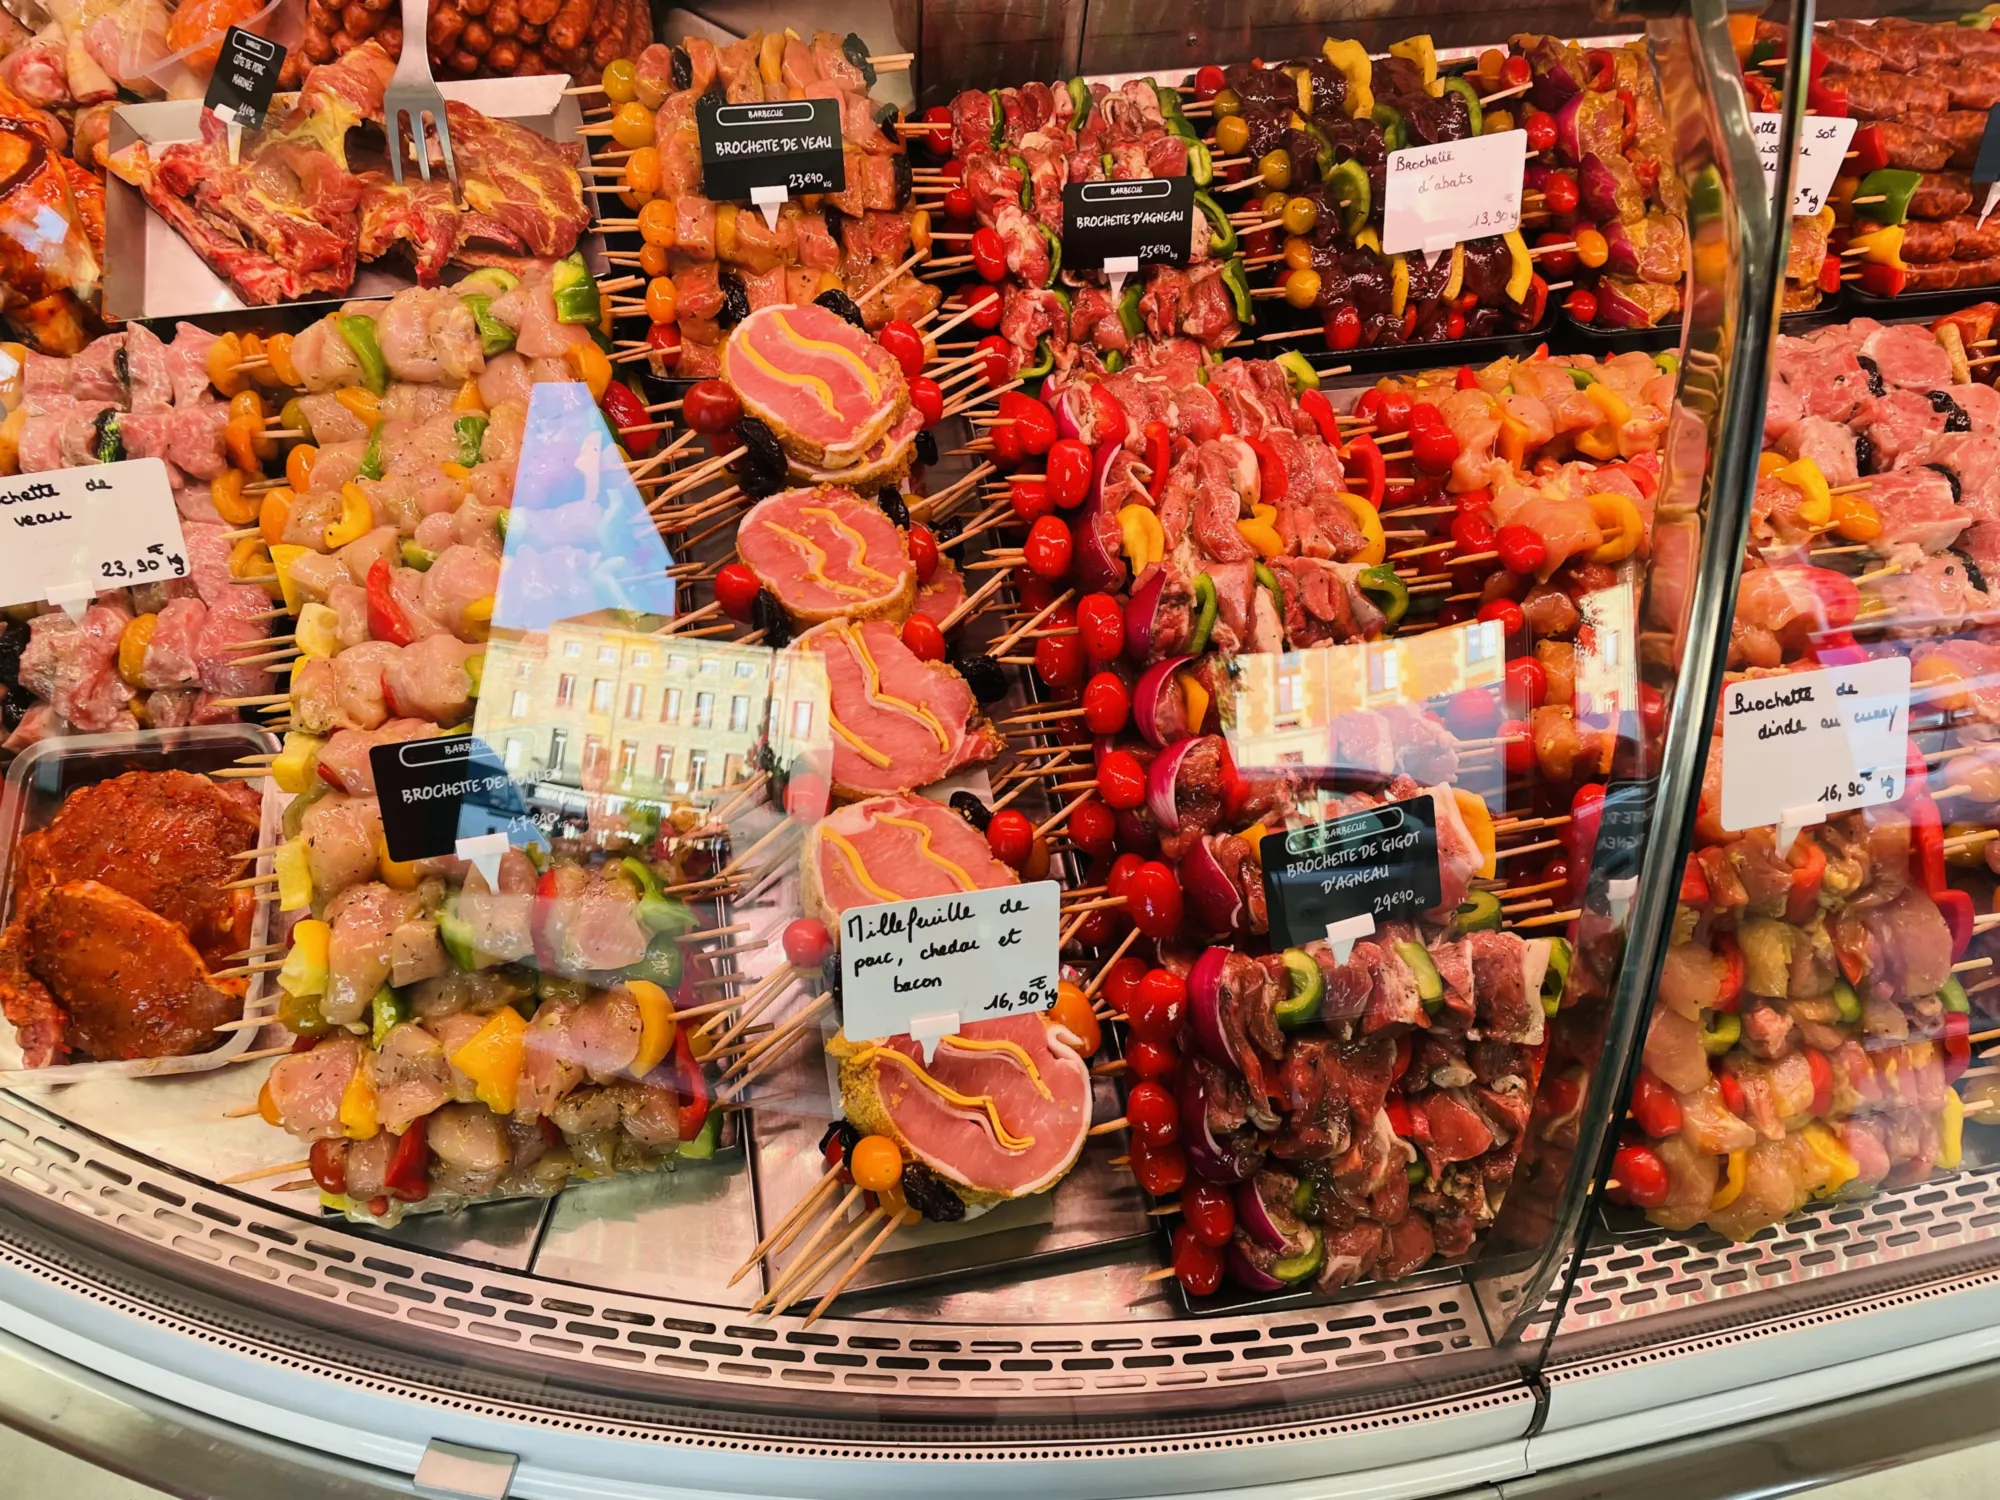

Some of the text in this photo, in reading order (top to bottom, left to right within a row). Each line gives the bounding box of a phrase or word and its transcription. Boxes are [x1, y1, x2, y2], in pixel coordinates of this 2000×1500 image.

[244, 59, 253, 70] DE
[747, 109, 784, 119] BARBECUE
[1815, 125, 1837, 139] sot
[715, 135, 832, 156] BROCHETTE DE VEAU
[1394, 150, 1455, 172] Brochette
[788, 172, 824, 189] 23€90
[1110, 186, 1143, 196] BARBECUE
[1418, 172, 1474, 194] d'abats
[1076, 210, 1184, 229] BROCHETTE D'AGNEAU
[1139, 244, 1171, 259] 25€90
[0, 478, 113, 505] chette de
[13, 510, 73, 528] veau
[1729, 682, 1859, 715] Brochette de
[1758, 705, 1898, 741] dinde au curry
[401, 767, 562, 804] BROCHETTE DE POULE
[1324, 821, 1368, 840] BARBECUE
[1286, 831, 1421, 879] BROCHETTE DE GIGOT
[1320, 864, 1390, 895] D'AGNEAU
[1374, 889, 1414, 915] 29€90
[847, 898, 1030, 943] Millefeuille de
[920, 939, 980, 960] chedar
[997, 928, 1023, 947] et
[893, 975, 942, 993] bacon
